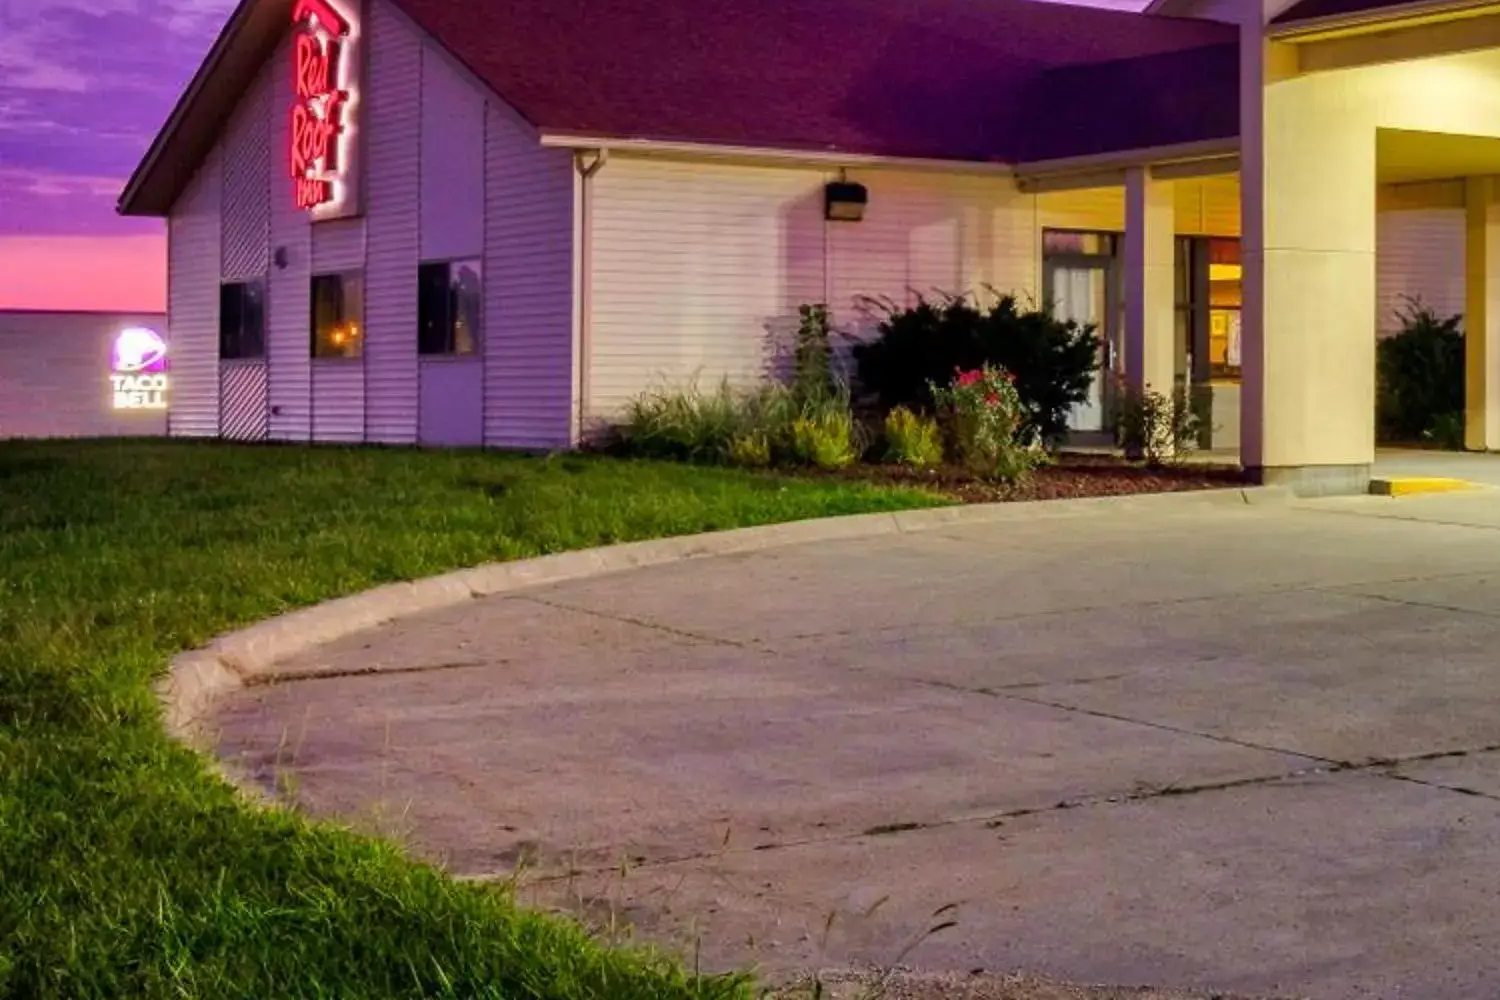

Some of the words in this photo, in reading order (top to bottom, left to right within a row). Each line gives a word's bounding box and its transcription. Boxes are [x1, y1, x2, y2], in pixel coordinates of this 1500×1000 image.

[292, 33, 339, 98] Red
[291, 90, 348, 179] Roof
[109, 375, 167, 391] TACO
[113, 391, 167, 408] BELL
